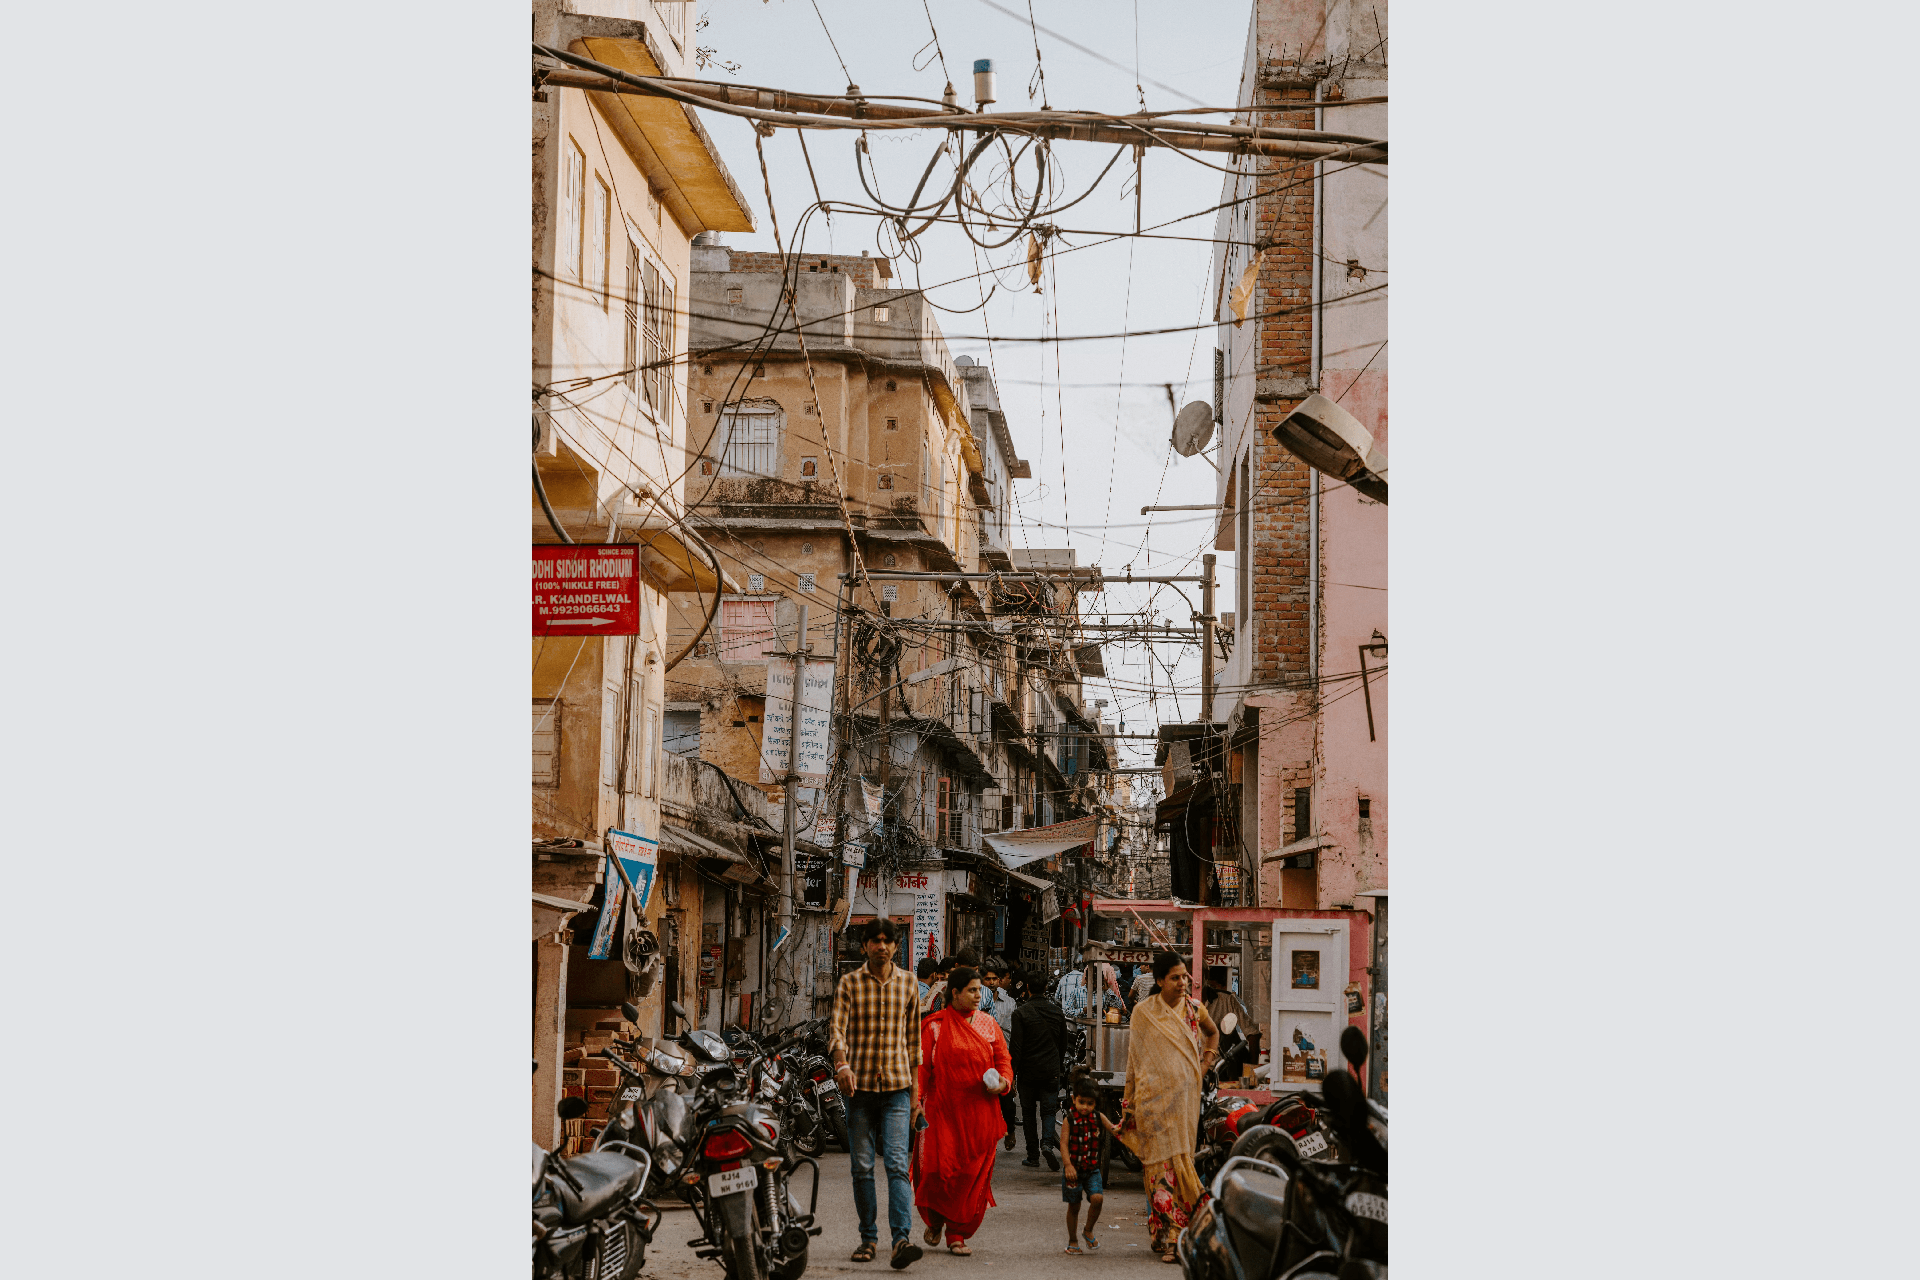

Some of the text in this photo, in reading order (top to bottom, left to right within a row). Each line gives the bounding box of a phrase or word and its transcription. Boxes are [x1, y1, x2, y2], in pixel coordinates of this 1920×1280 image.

[556, 559, 587, 578] SIDDHI
[590, 559, 632, 578] RHODIUM
[535, 581, 620, 591] (100% NIKKLE FREE)
[550, 594, 631, 605] KHANDELWAL
[539, 604, 620, 615] M.9929066643
[1206, 953, 1229, 966] डार
[1298, 1137, 1315, 1149] RJ14
[721, 1172, 740, 1182] RJ14
